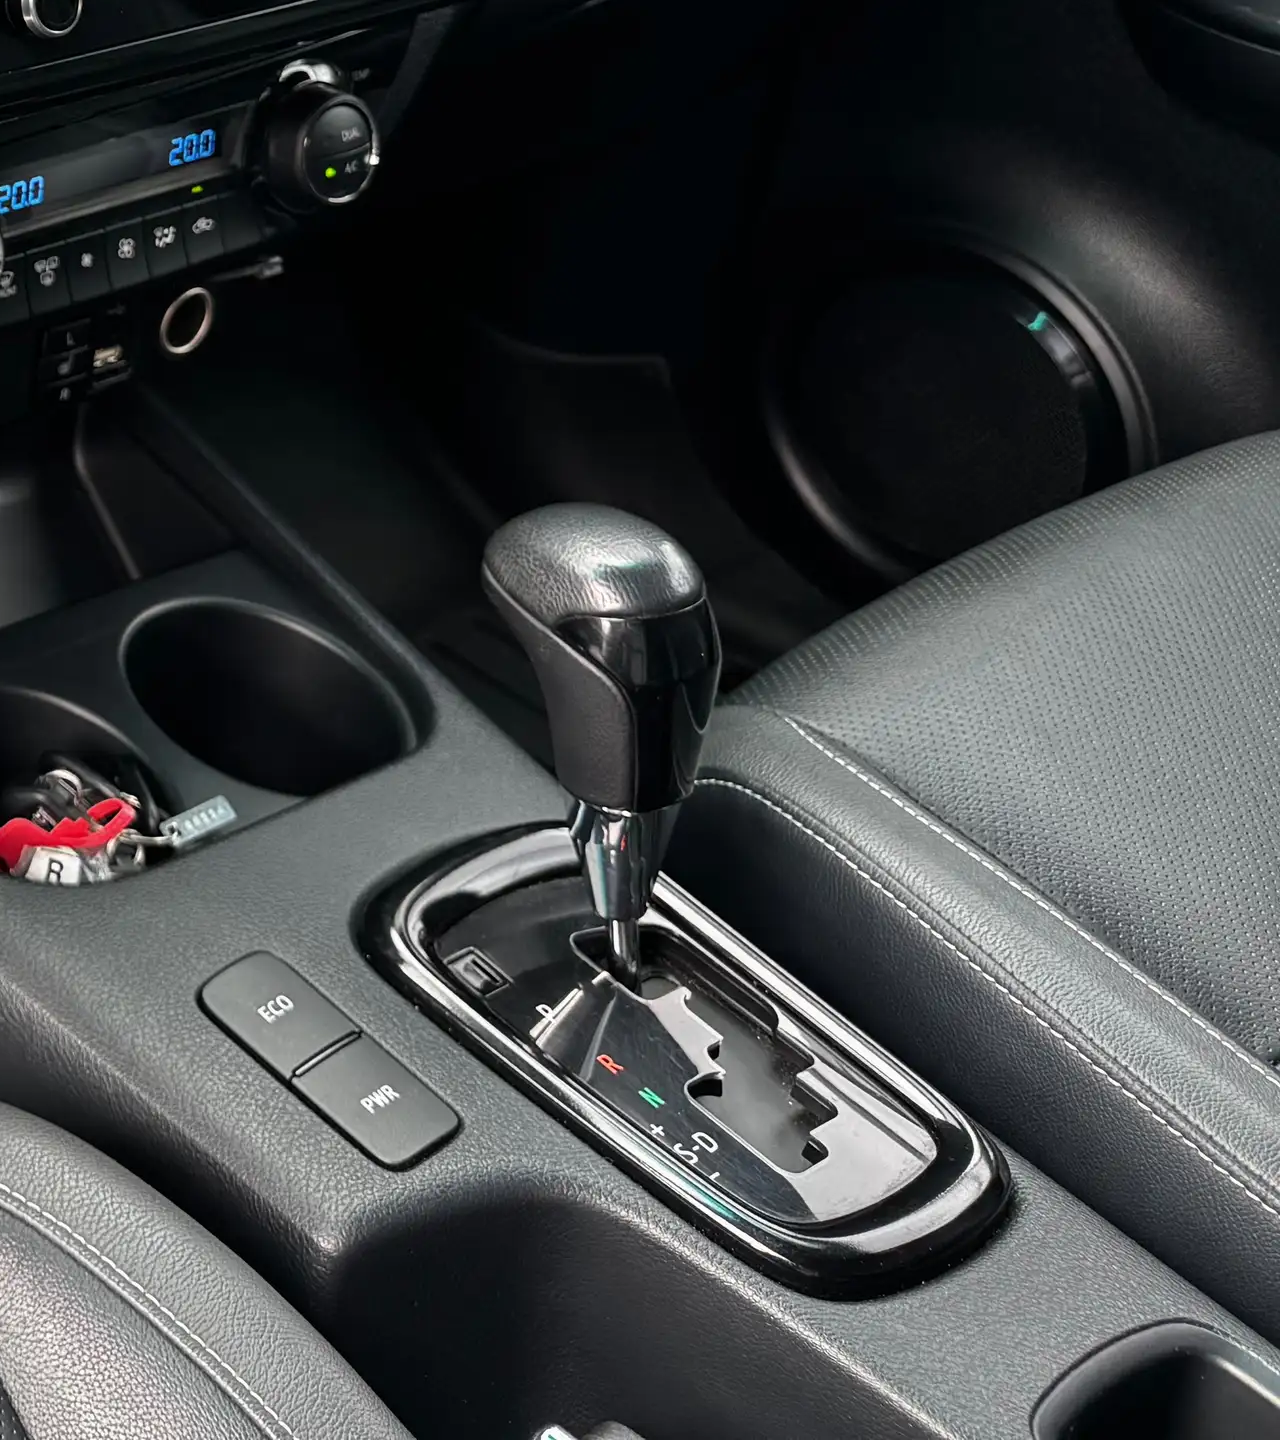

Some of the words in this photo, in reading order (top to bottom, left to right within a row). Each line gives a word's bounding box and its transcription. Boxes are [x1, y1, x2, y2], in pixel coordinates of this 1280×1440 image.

[168, 129, 216, 166] 20.0
[257, 994, 294, 1024] ECO
[596, 1054, 624, 1076] R
[360, 1084, 400, 1114] PWR
[638, 1086, 666, 1109] N
